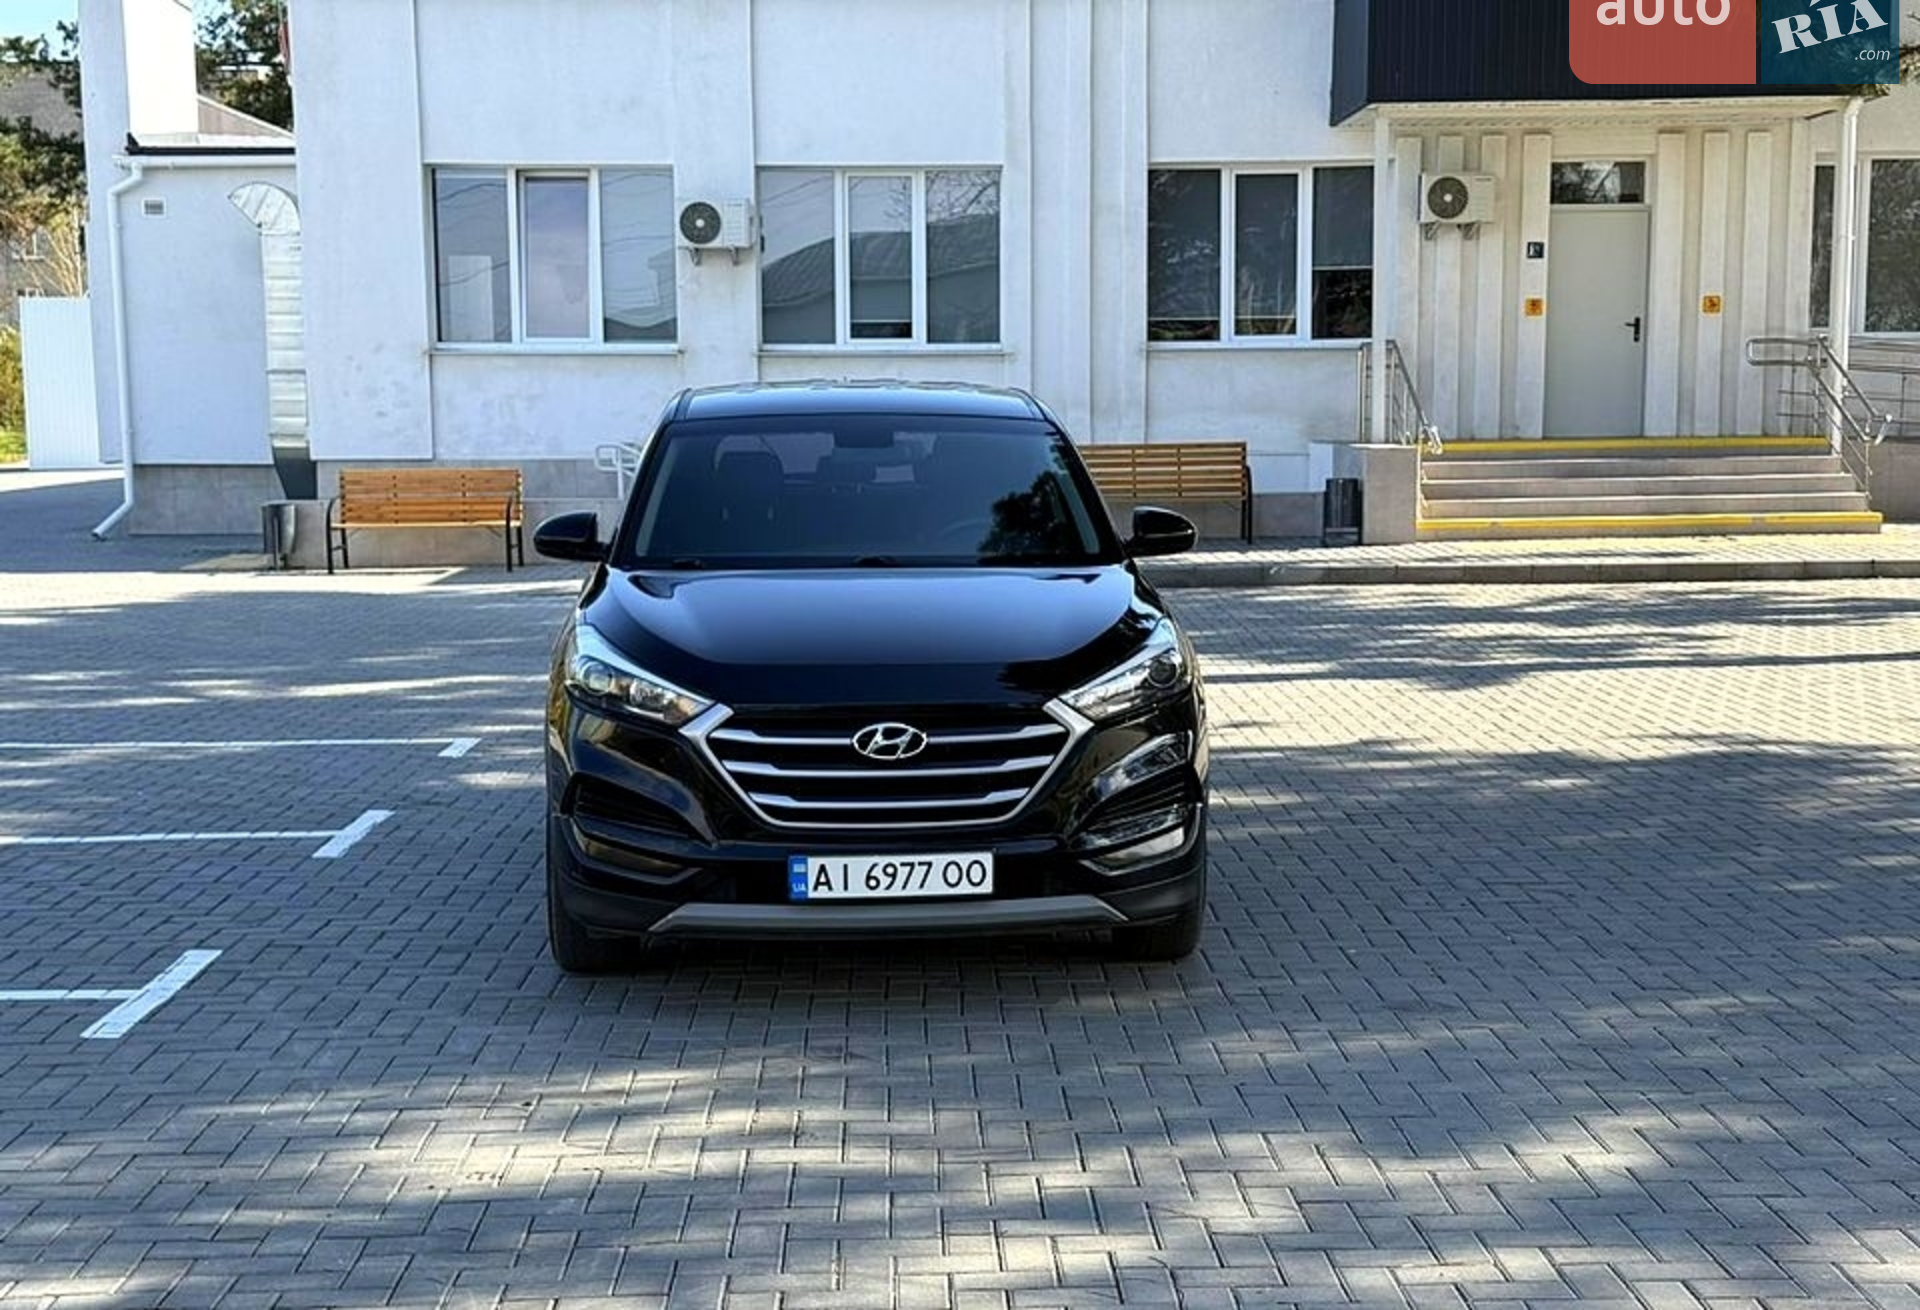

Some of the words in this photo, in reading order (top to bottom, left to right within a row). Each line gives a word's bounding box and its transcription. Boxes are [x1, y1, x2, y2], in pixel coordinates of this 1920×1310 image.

[812, 863, 849, 892] AI
[864, 861, 933, 891] 6977
[942, 859, 987, 888] OO
